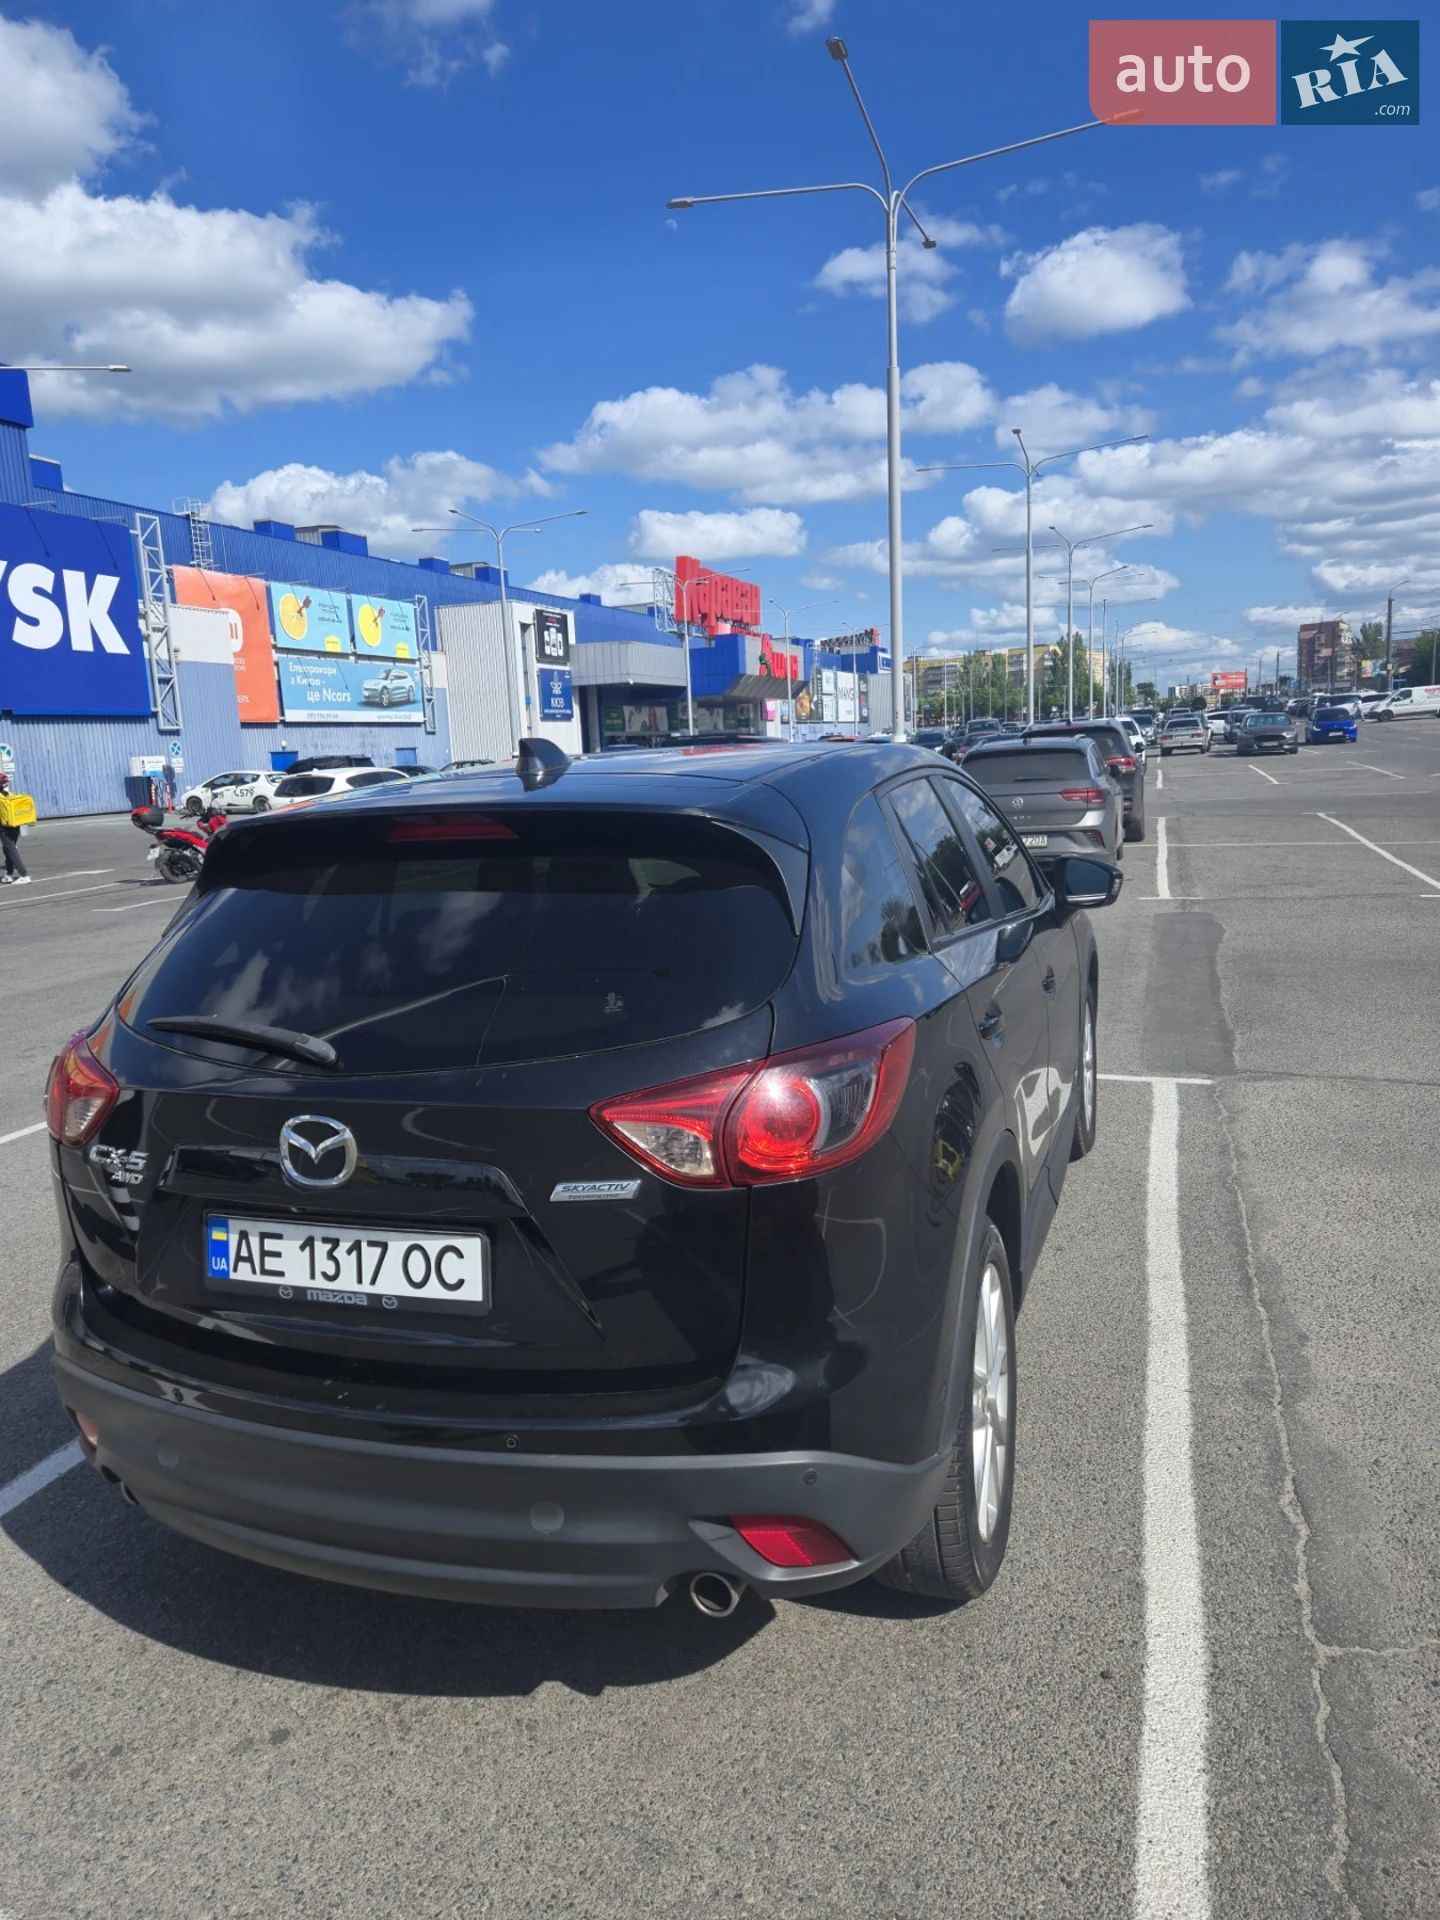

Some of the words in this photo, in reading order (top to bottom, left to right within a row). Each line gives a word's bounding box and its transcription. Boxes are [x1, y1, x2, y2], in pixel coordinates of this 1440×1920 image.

[288, 662, 337, 676] Електрокари
[307, 691, 320, 703] це
[322, 688, 351, 703] Ncars
[239, 788, 254, 798] 579
[89, 1144, 149, 1171] CX-5
[110, 1170, 144, 1185] AWD
[560, 1183, 631, 1193] SKYACTIV
[211, 1256, 228, 1271] UA
[232, 1229, 286, 1278] AE
[299, 1235, 389, 1286] 1317
[401, 1243, 466, 1292] OC
[306, 1288, 368, 1307] mazda
